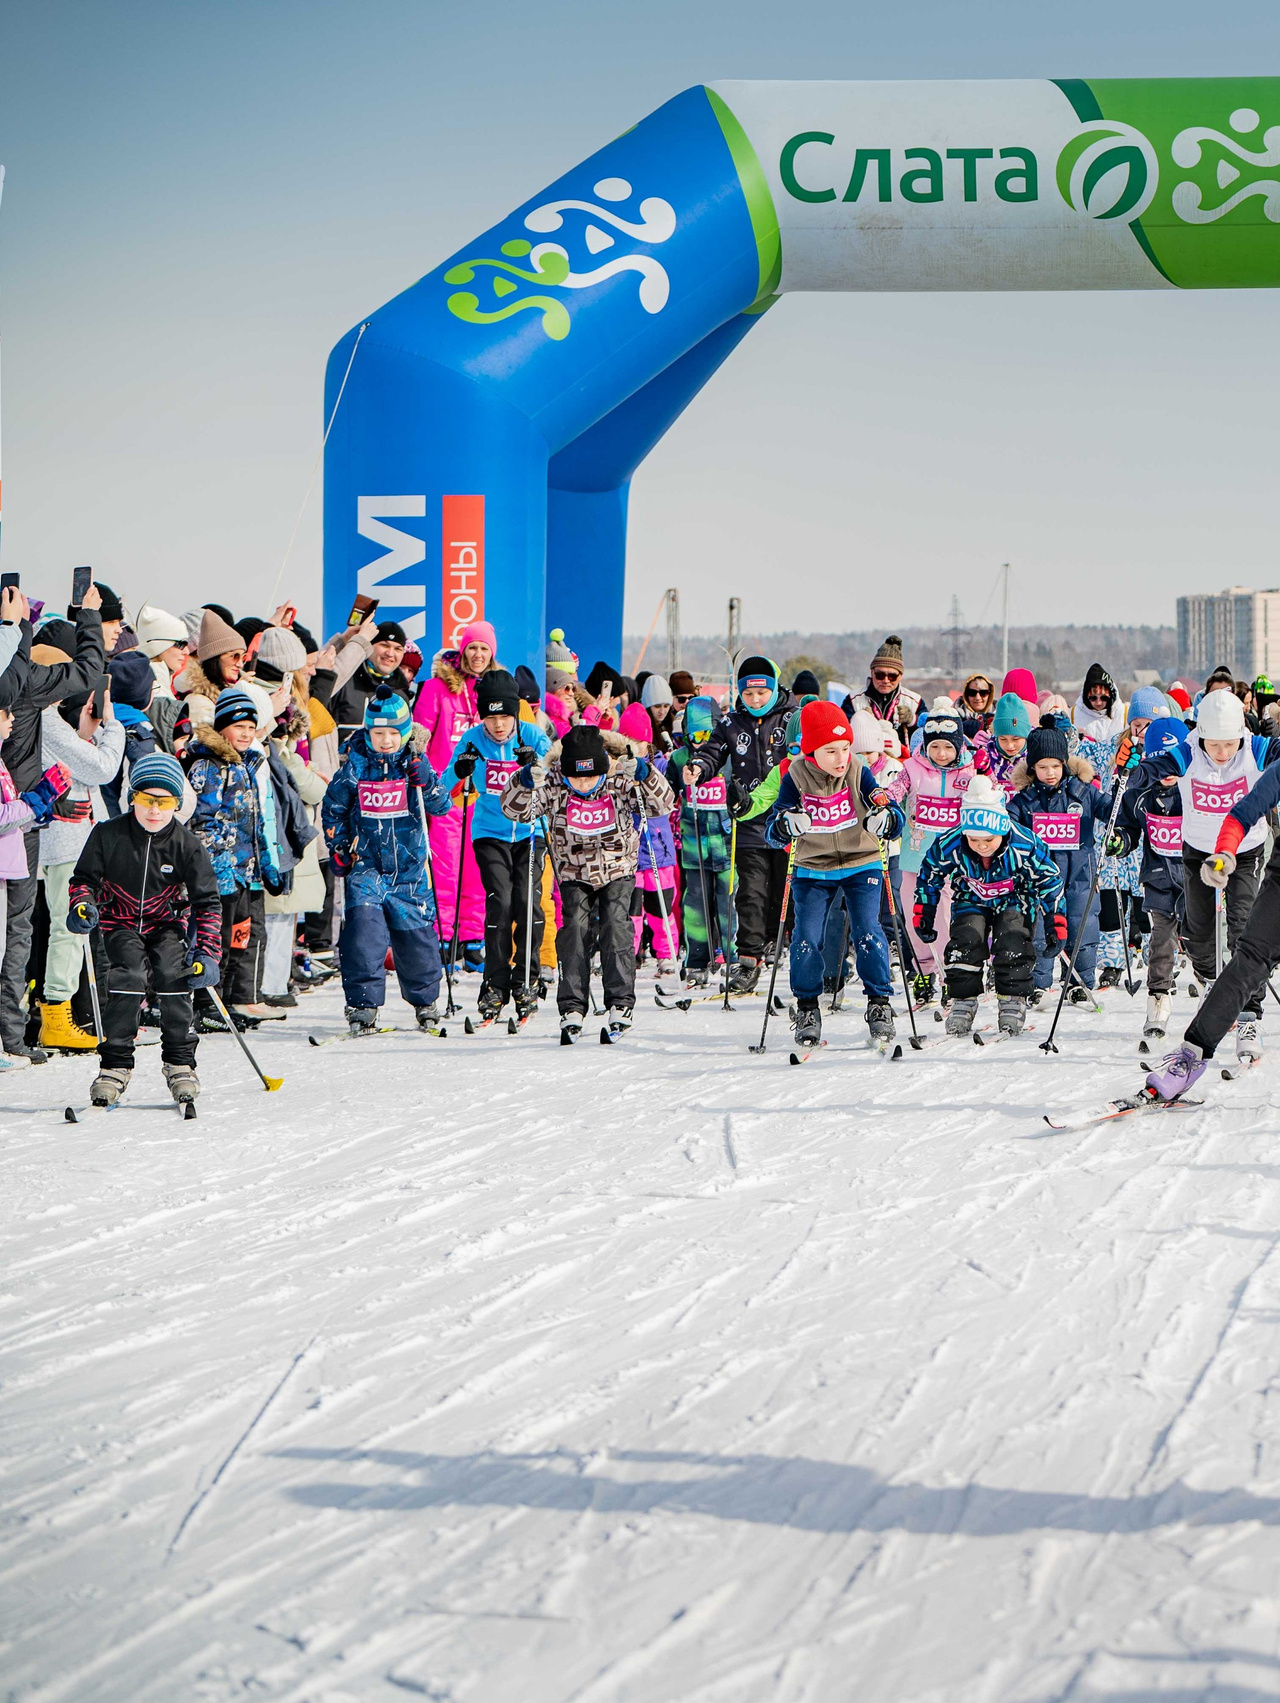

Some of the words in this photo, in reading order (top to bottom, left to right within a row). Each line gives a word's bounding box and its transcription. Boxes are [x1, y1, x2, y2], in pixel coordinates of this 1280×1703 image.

[779, 131, 1039, 203] Слата
[363, 791, 402, 807] 2027
[690, 787, 722, 800] 2013
[1195, 788, 1245, 808] 2036
[571, 808, 610, 825] 2031
[807, 800, 851, 821] 2058
[919, 805, 958, 822] 2055
[961, 810, 1001, 831] ОССИИ
[1036, 824, 1076, 838] 2035
[1149, 826, 1183, 844] 202
